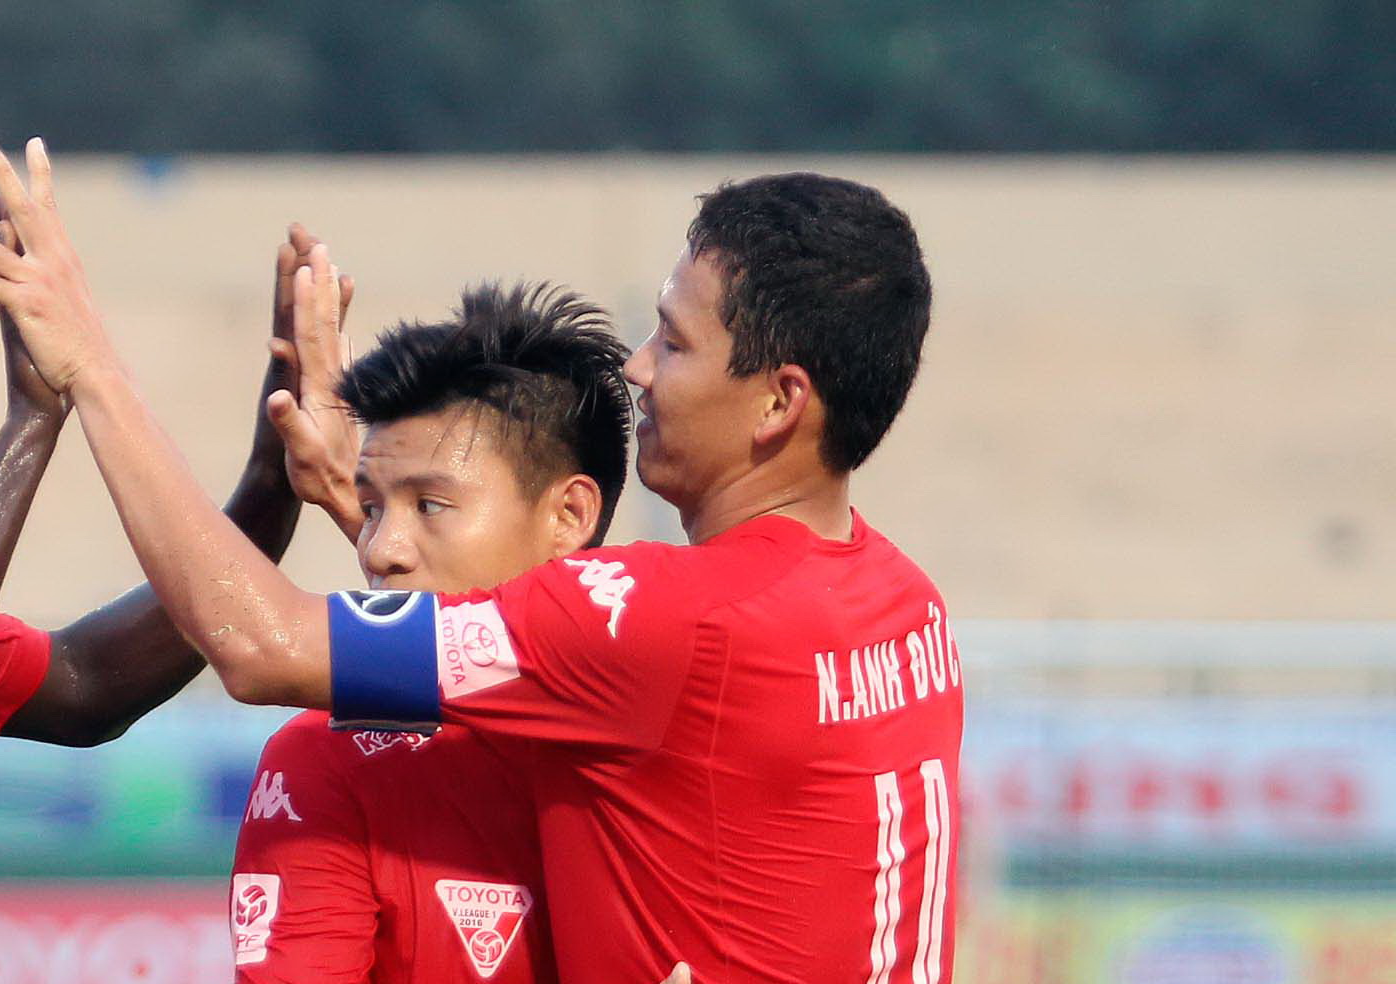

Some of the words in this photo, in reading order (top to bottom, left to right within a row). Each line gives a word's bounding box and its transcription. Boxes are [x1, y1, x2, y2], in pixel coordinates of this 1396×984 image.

[442, 616, 467, 686] TOYOTA
[814, 639, 906, 724] N.ANH
[444, 885, 527, 907] TOYOTA
[452, 907, 490, 919] V.LEAGUE
[459, 918, 484, 927] 2016
[235, 933, 261, 949] PF
